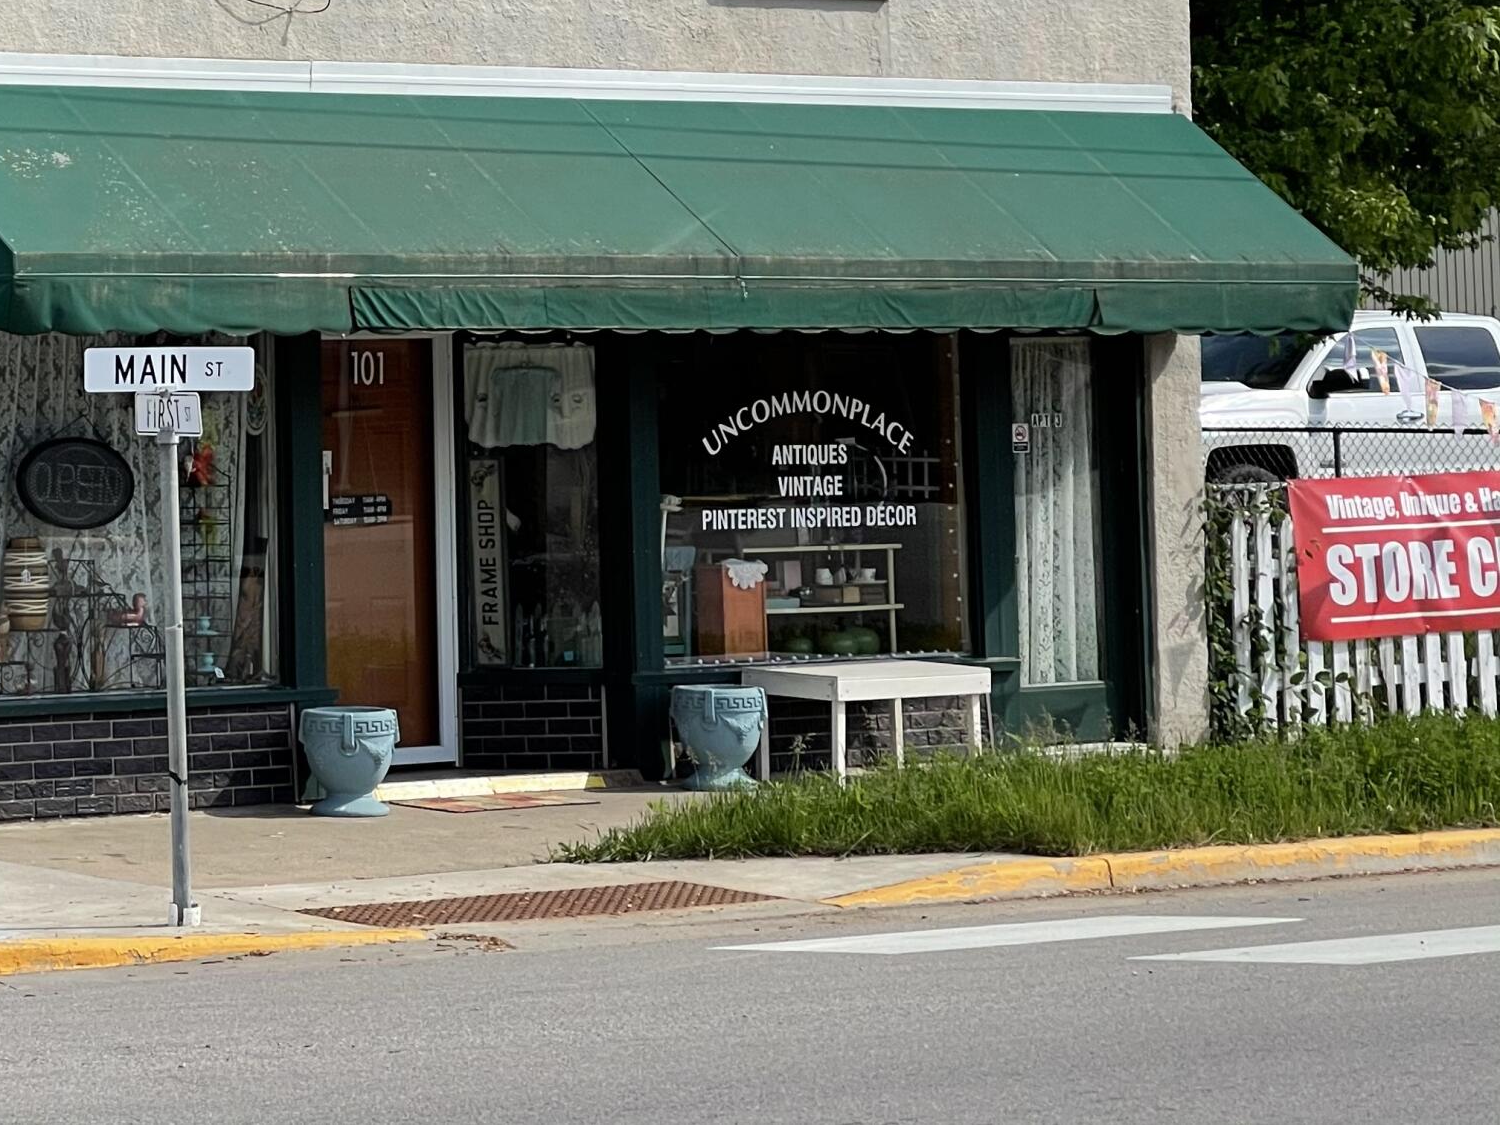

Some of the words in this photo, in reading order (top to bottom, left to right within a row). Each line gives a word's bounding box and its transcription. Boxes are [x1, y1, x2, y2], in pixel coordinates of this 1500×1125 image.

[114, 354, 187, 385] MAIN
[205, 361, 224, 377] ST
[351, 351, 385, 385] 101
[146, 397, 180, 429] FIRST
[702, 390, 915, 456] UNCOMMONPLACE
[772, 443, 848, 466] ANTIQUES
[778, 475, 844, 497] VINTAGE
[702, 508, 786, 531] PINTEREST
[790, 506, 862, 529] INSPIRED
[1325, 493, 1400, 521] Vintage,
[1400, 490, 1461, 517] Unique
[1464, 491, 1479, 513] &
[478, 499, 497, 551] SHOP
[1326, 539, 1461, 606] STORE
[1467, 536, 1500, 598] C
[478, 556, 500, 627] FRAME
